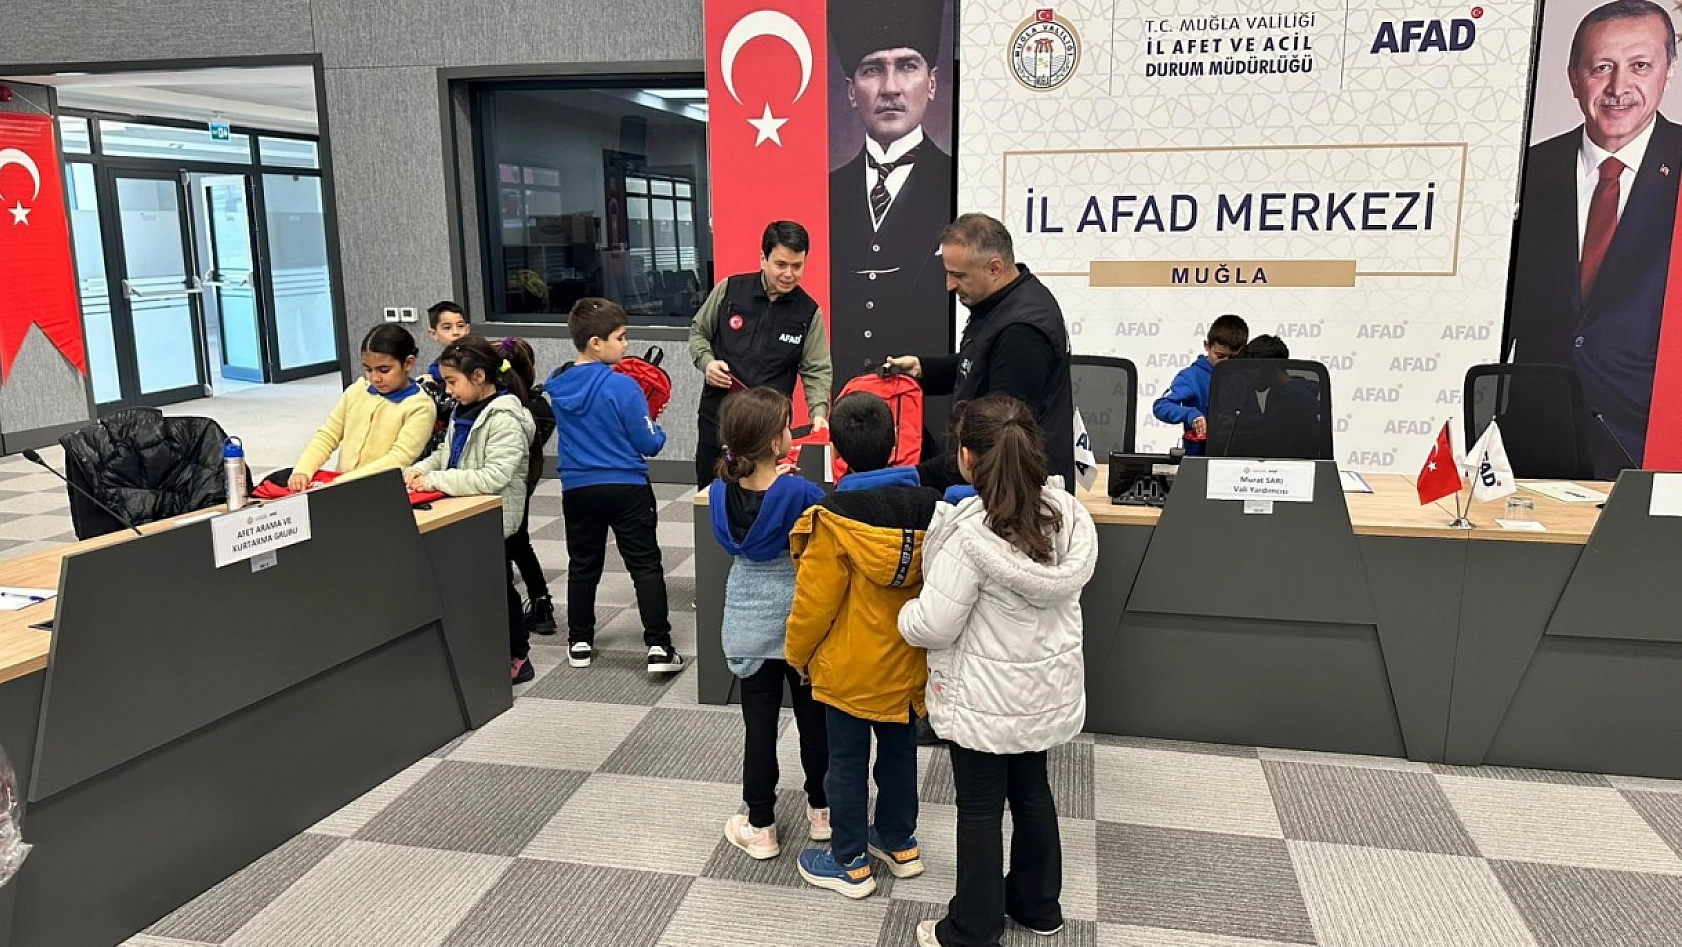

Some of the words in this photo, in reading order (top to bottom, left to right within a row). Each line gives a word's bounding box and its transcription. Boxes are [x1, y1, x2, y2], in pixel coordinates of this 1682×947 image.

[1145, 19, 1173, 33] T.C.
[1179, 14, 1240, 32] MUĞLA
[1246, 12, 1316, 30] VALİLİĞİ
[1146, 37, 1165, 55] İL
[1172, 38, 1222, 55] AFET
[1230, 37, 1255, 52] VE
[1263, 32, 1312, 52] ACİL
[1369, 18, 1476, 54] AFAD
[1145, 61, 1204, 77] DURUM
[1208, 54, 1313, 76] MÜDÜRLÜĞÜ
[1025, 187, 1064, 233] İL
[1076, 193, 1198, 233] AFAD
[1216, 181, 1436, 233] MERKEZİ
[1171, 262, 1269, 284] MUĞLA
[1115, 322, 1160, 337] AFAD
[1275, 322, 1322, 338] AFAD
[1356, 323, 1405, 339] AFAD
[1441, 325, 1491, 340] AFAD
[779, 333, 801, 345] AFAD
[1145, 352, 1191, 368] AFAD
[1389, 356, 1438, 372] AFAD
[1352, 387, 1400, 403] AFAD
[1384, 419, 1432, 436] AFAD
[1347, 450, 1395, 466] AFAD
[237, 527, 254, 539] AFET
[255, 520, 282, 534] ARAMA
[282, 516, 292, 526] VE
[232, 534, 273, 553] KURTARMA
[273, 526, 298, 541] GRUBU
